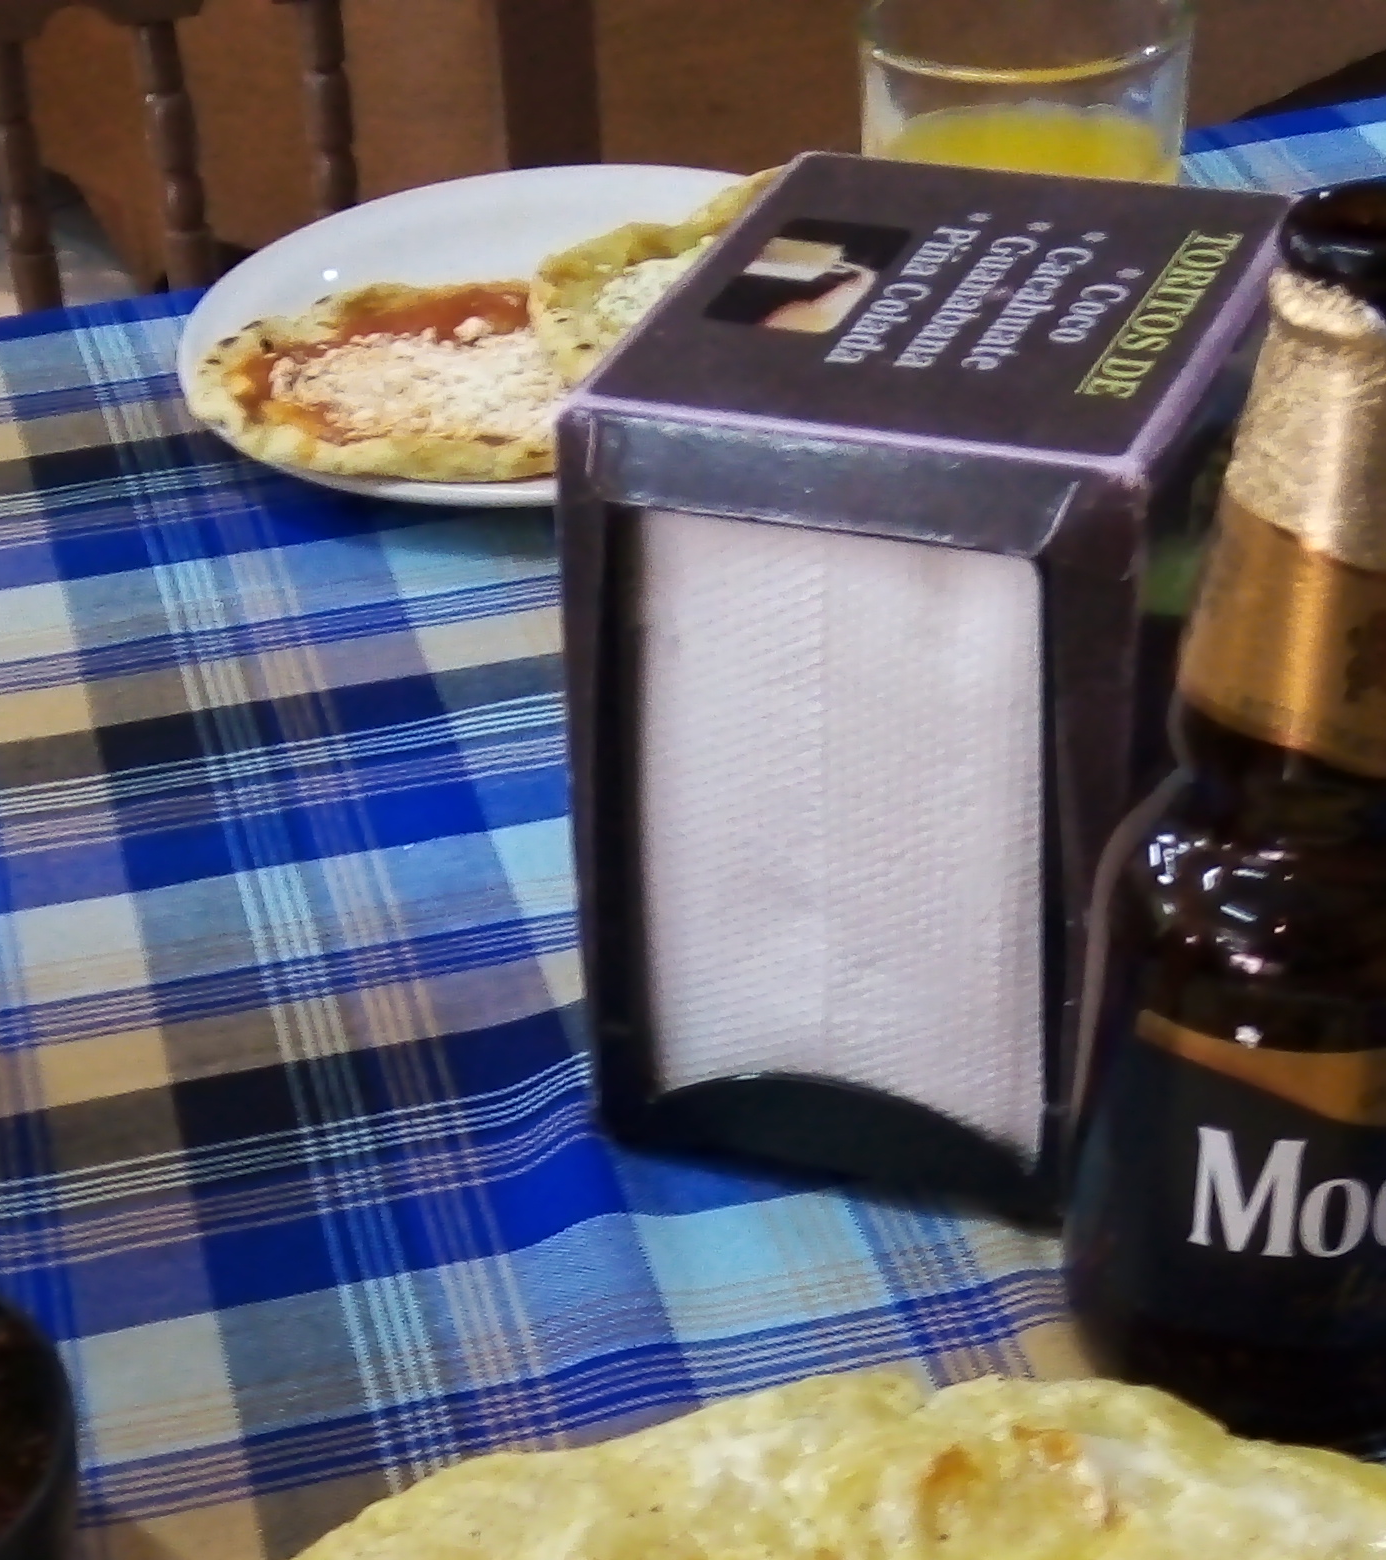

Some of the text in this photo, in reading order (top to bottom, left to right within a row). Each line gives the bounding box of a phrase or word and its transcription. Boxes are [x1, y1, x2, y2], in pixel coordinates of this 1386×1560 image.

[823, 226, 982, 364] Piña Colada
[960, 246, 1095, 371] Cacahuate
[1048, 283, 1131, 343] Coco
[1082, 231, 1245, 399] TORITOS DE
